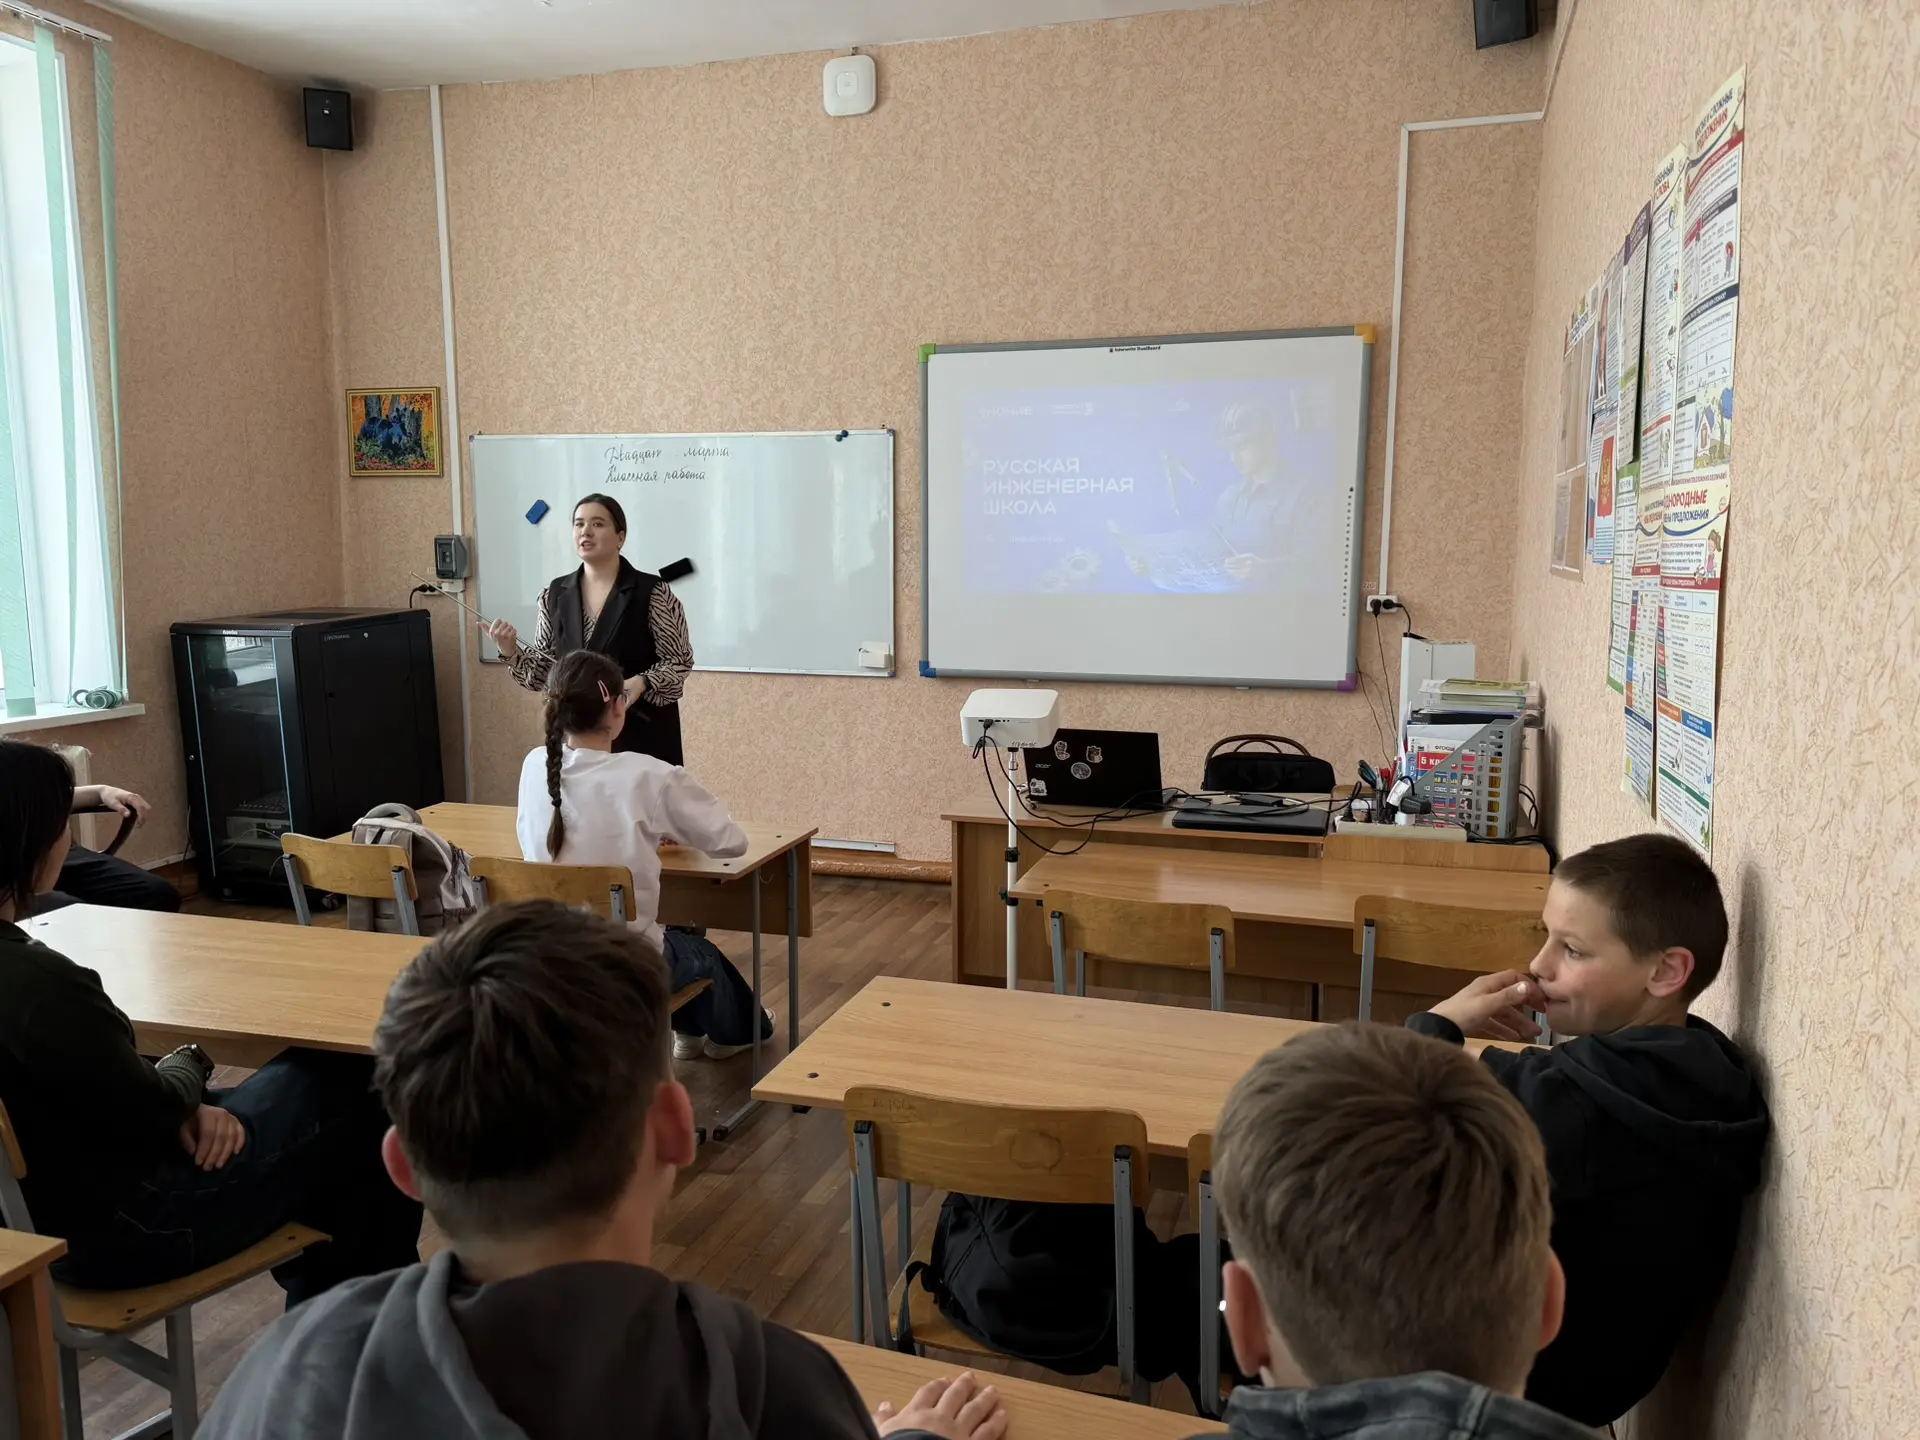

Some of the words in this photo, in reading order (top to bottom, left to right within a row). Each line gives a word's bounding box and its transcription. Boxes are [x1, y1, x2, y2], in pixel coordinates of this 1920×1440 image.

[605, 464, 659, 483] Классная
[663, 465, 705, 483] работа
[983, 457, 1080, 475] РУССКАЯ
[983, 477, 1135, 496] ИНЖЕНЕРНАЯ
[983, 499, 1057, 515] ШКОЛА
[1421, 757, 1427, 765] 5
